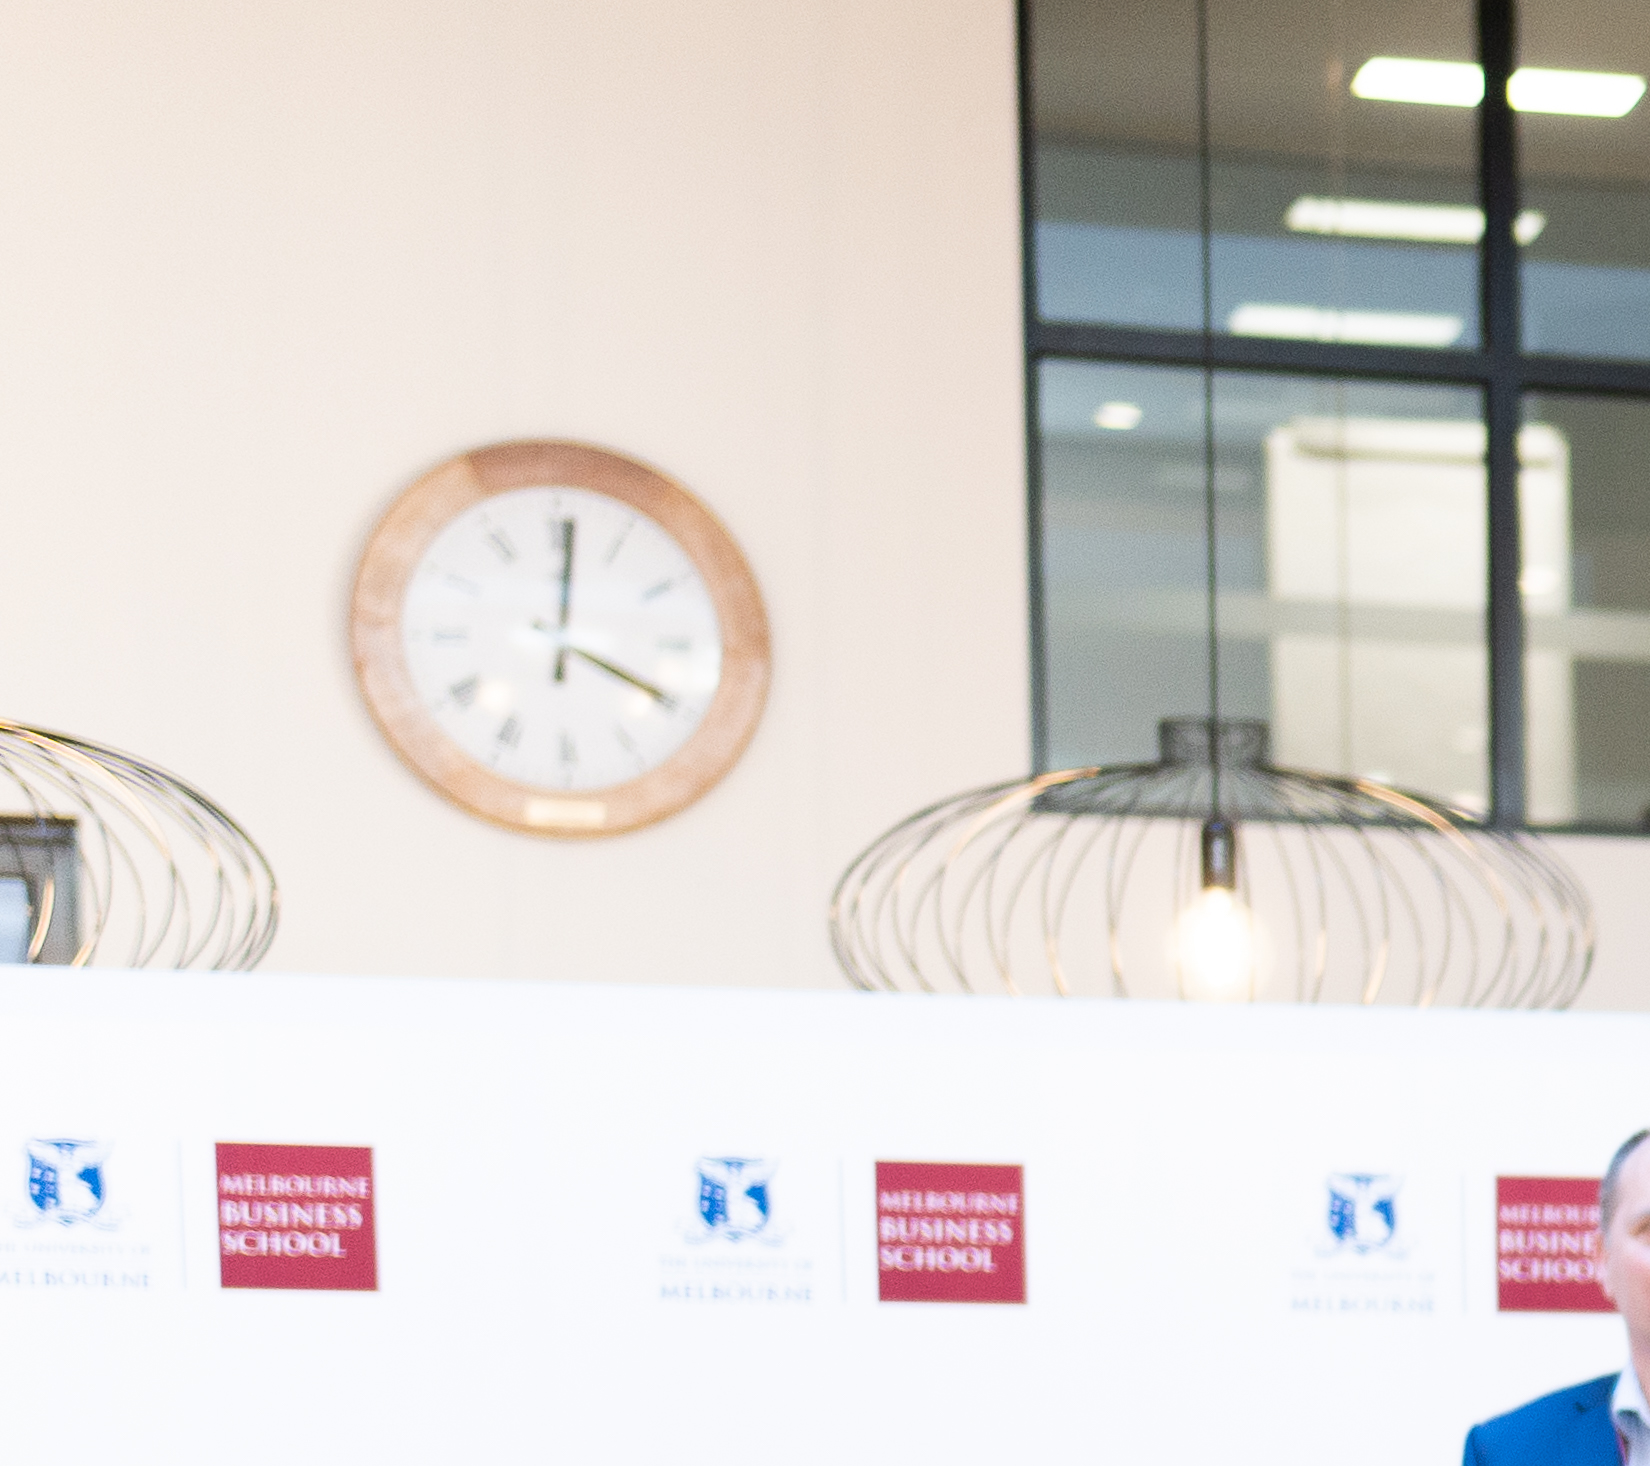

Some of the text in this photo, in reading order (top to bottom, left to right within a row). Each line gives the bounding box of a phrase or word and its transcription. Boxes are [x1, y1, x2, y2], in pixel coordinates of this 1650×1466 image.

[219, 1174, 370, 1198] MELBOURNE
[220, 1200, 363, 1230] BUSINESS
[879, 1190, 1019, 1216] MELBOURNE
[221, 1230, 347, 1258] SCHOOL
[879, 1216, 1013, 1245] BUSINESS
[1500, 1229, 1595, 1254] BUSINE
[880, 1245, 998, 1273] SCHOOL
[1499, 1257, 1595, 1282] SCHOO
